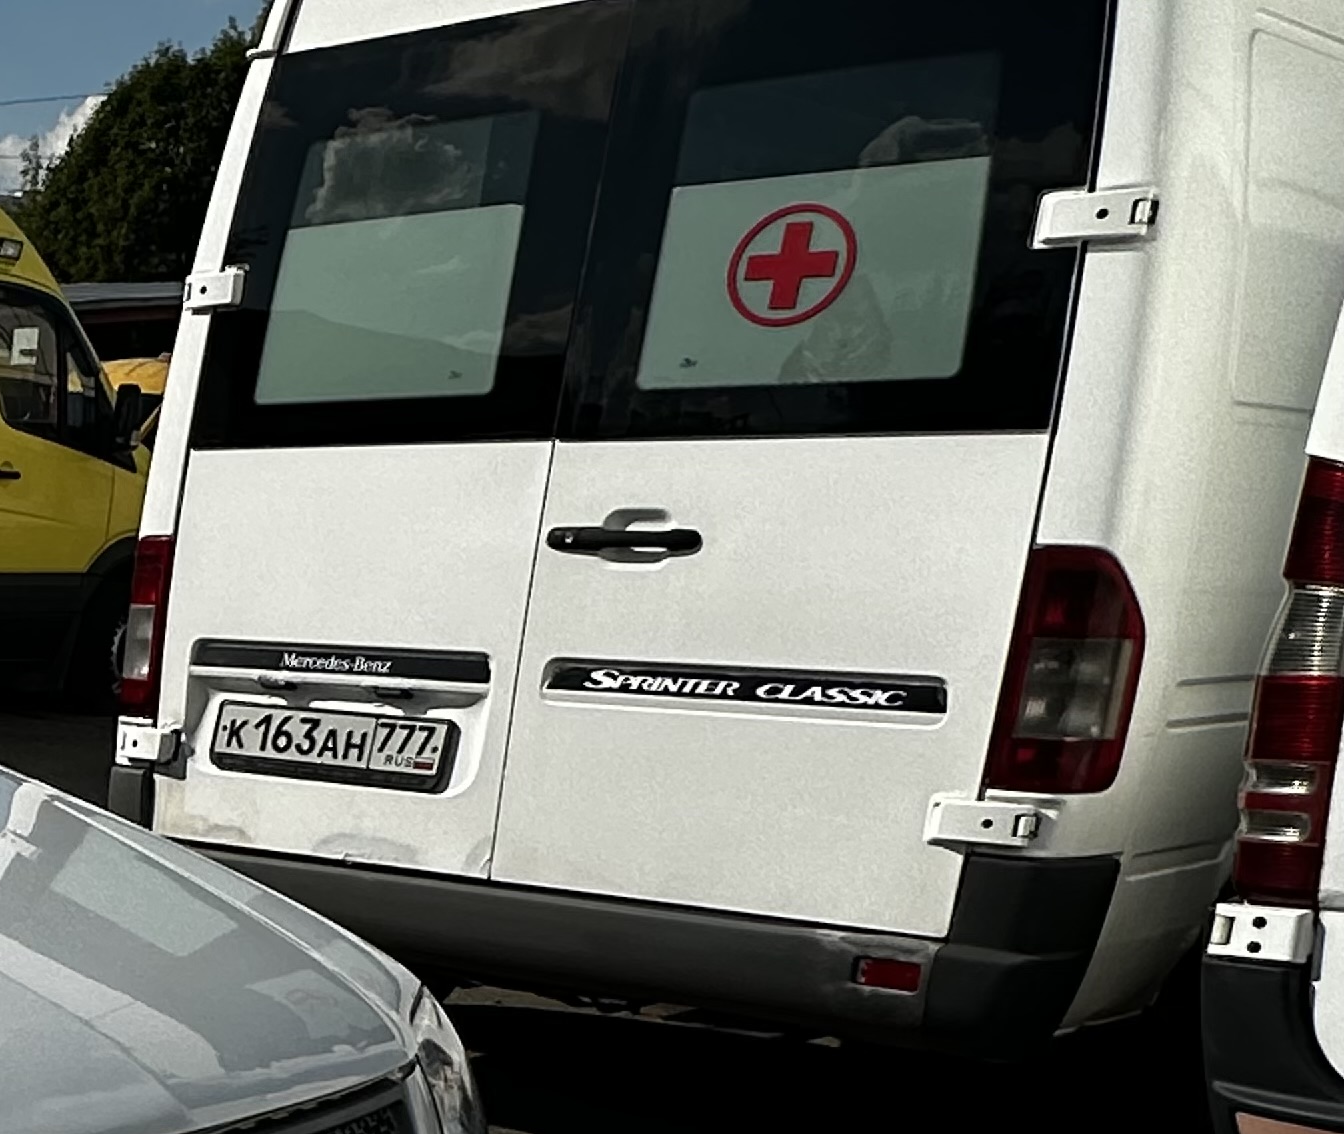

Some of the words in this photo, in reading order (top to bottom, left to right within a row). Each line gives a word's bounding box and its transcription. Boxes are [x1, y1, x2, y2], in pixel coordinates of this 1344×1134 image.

[279, 652, 392, 673] Mercedes-Benz
[583, 668, 740, 696] SPRINTER
[755, 682, 908, 707] CLASSIC
[225, 713, 368, 762] К163АН
[377, 722, 437, 756] 777
[383, 754, 414, 768] RUS
